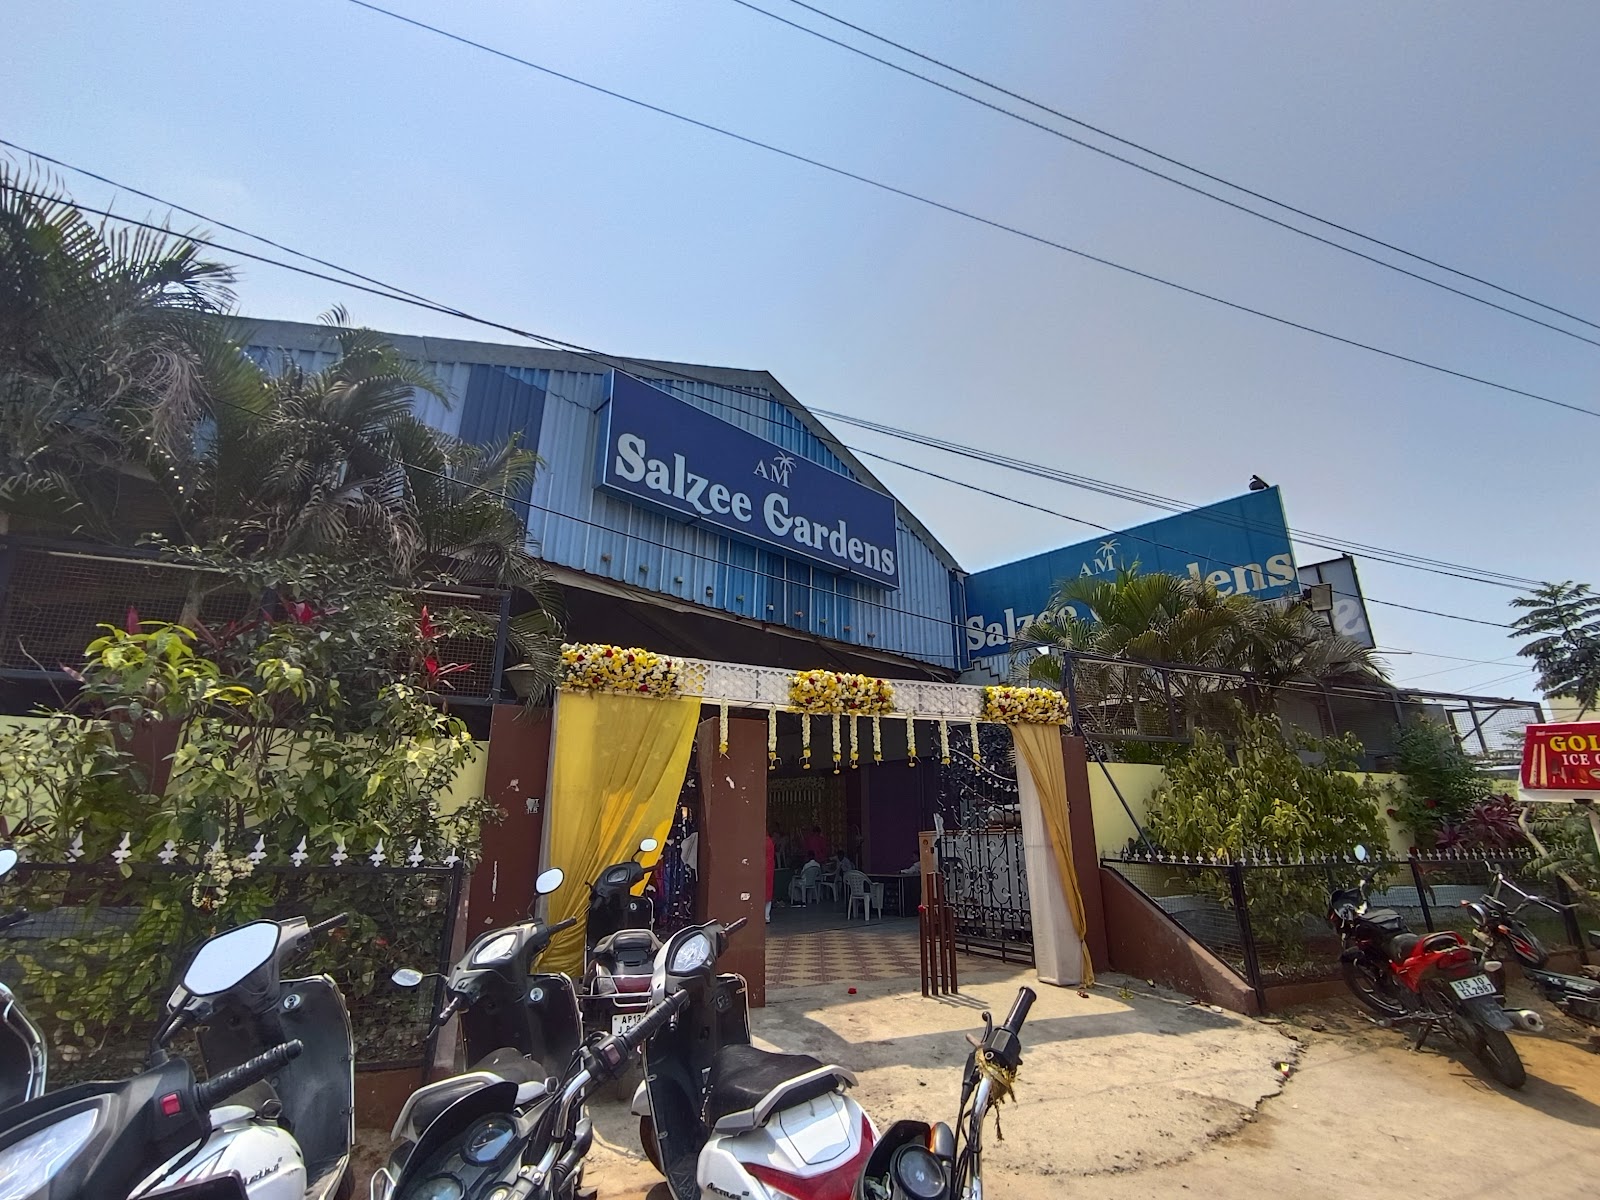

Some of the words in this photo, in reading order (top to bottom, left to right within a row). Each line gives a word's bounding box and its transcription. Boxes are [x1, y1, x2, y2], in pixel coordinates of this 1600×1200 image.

[753, 459, 790, 489] AM
[615, 432, 752, 522] Salzee
[763, 492, 896, 576] Gardens
[1079, 554, 1117, 579] AM
[1561, 753, 1591, 766] ICE
[1457, 980, 1471, 990] TS
[1472, 977, 1485, 986] 10
